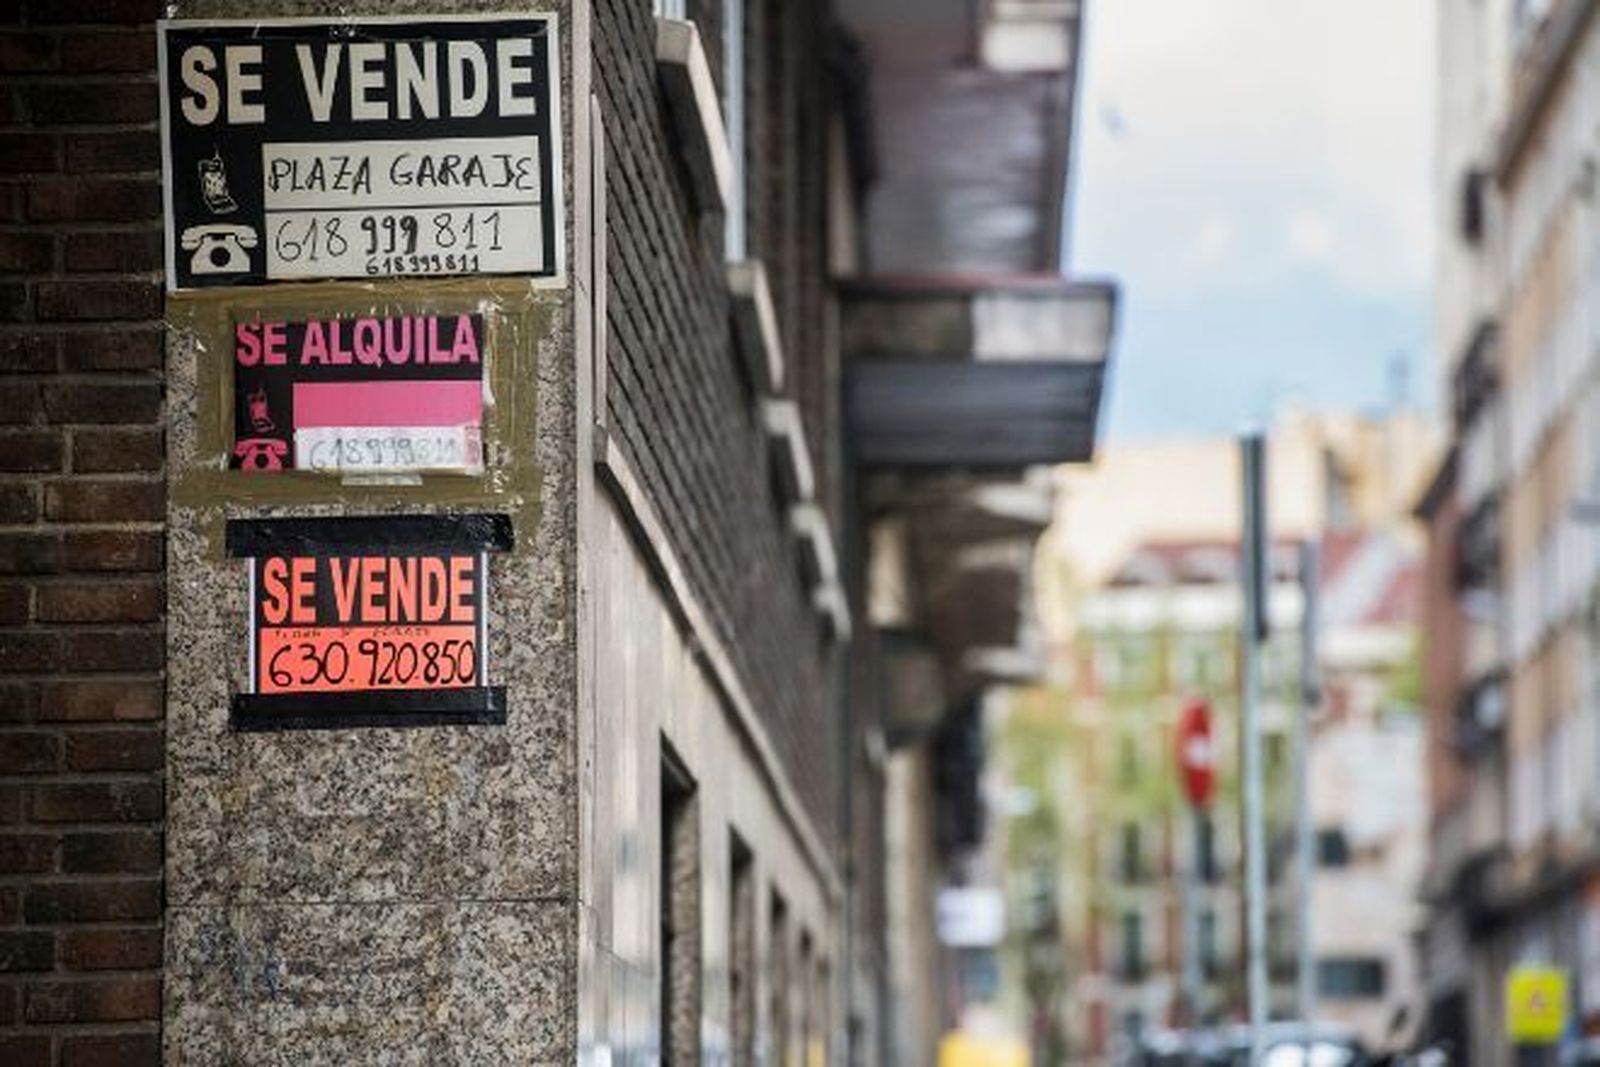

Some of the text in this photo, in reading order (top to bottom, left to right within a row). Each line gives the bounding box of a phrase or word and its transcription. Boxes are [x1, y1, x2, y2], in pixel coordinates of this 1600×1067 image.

[181, 38, 536, 125] SE VENDE
[268, 153, 534, 195] PLAZA GARAJE
[275, 210, 502, 262] 618 999 811
[236, 314, 479, 368] SE ALQUILA
[262, 557, 475, 623] SE VENDE
